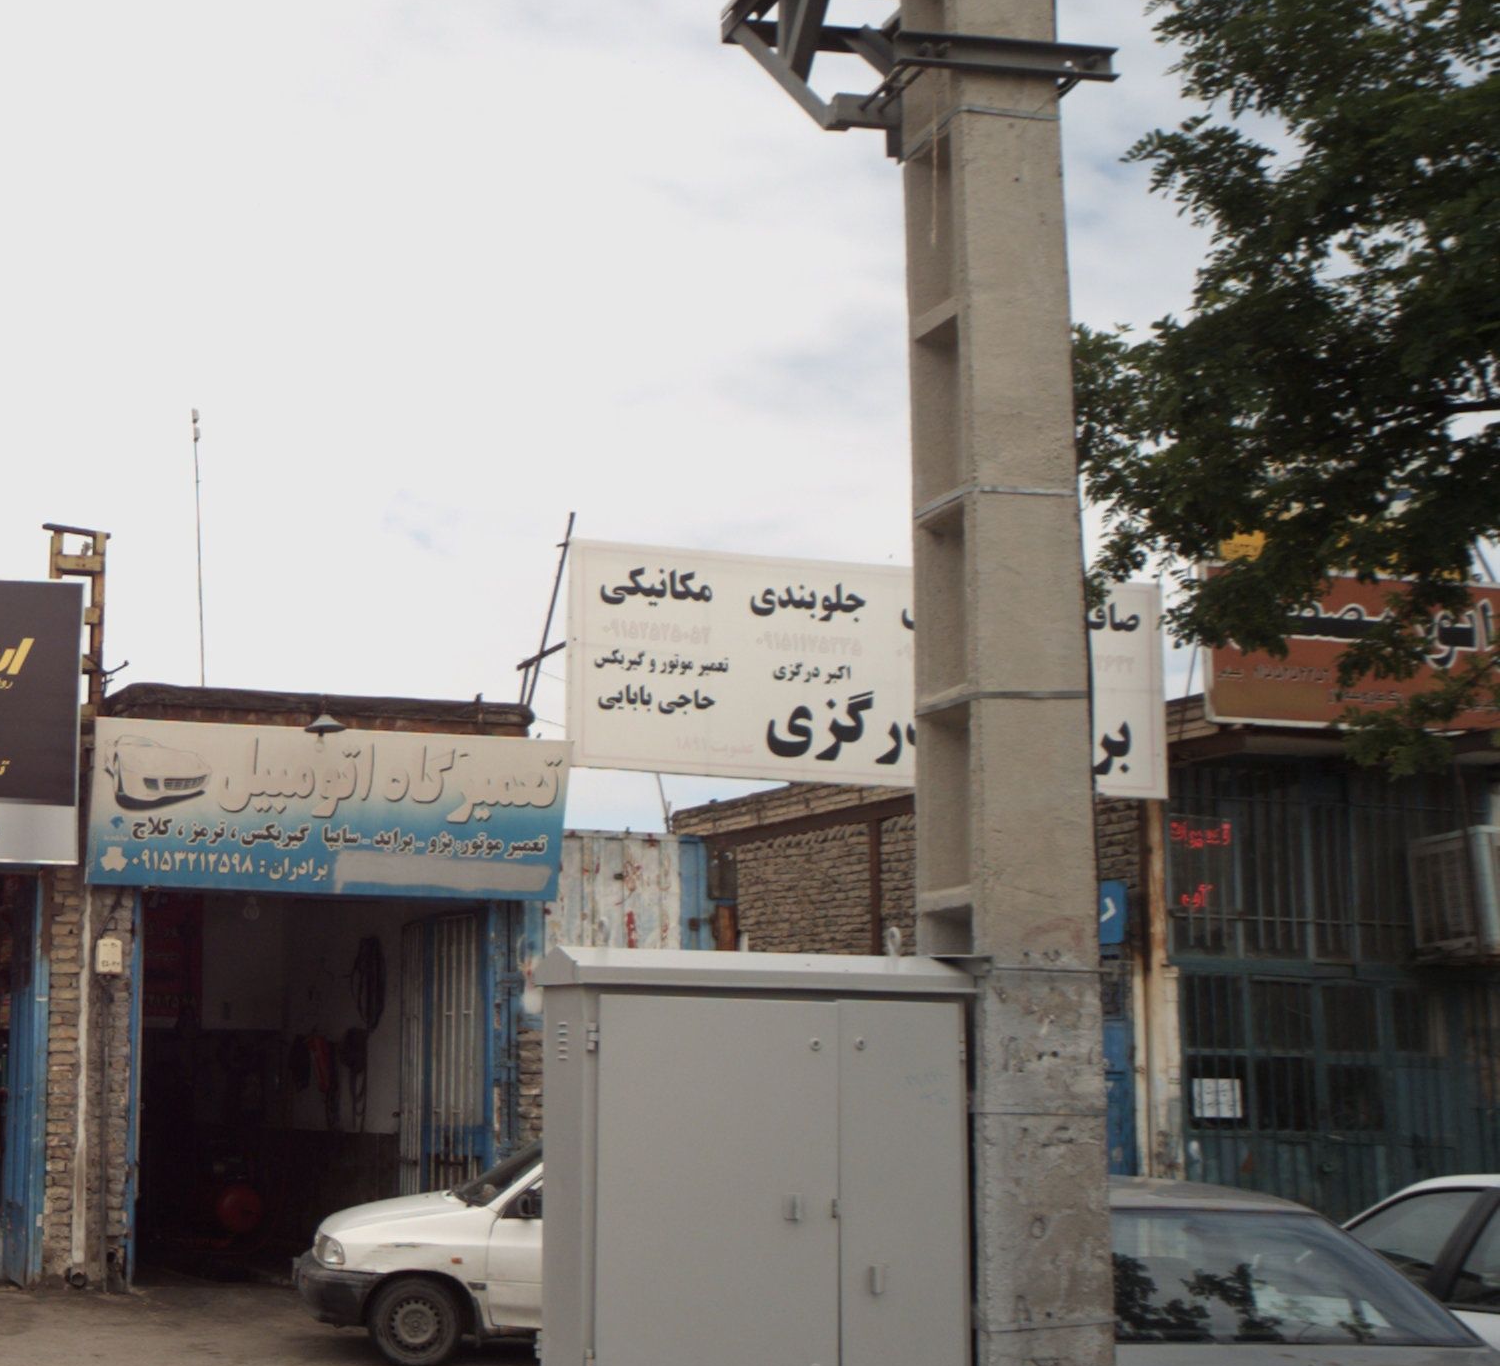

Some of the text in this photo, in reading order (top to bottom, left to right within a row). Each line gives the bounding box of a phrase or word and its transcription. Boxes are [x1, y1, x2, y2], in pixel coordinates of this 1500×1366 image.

[600, 567, 713, 607] مکانیکی
[750, 582, 866, 623] جلوبندی
[594, 648, 729, 677] تعمیر موتور و گیربکس
[824, 665, 852, 684] اکبر
[597, 683, 716, 715] حاجی بابایی
[218, 737, 376, 818] اتومبیل
[131, 815, 173, 841] کلاچ
[187, 820, 228, 845] ترمز
[240, 823, 311, 849] گیربکس
[321, 823, 361, 851] سایپا
[373, 827, 417, 854] پراید
[427, 831, 454, 857] پژو
[506, 834, 548, 858] تعمیر
[268, 856, 329, 882] برادران
